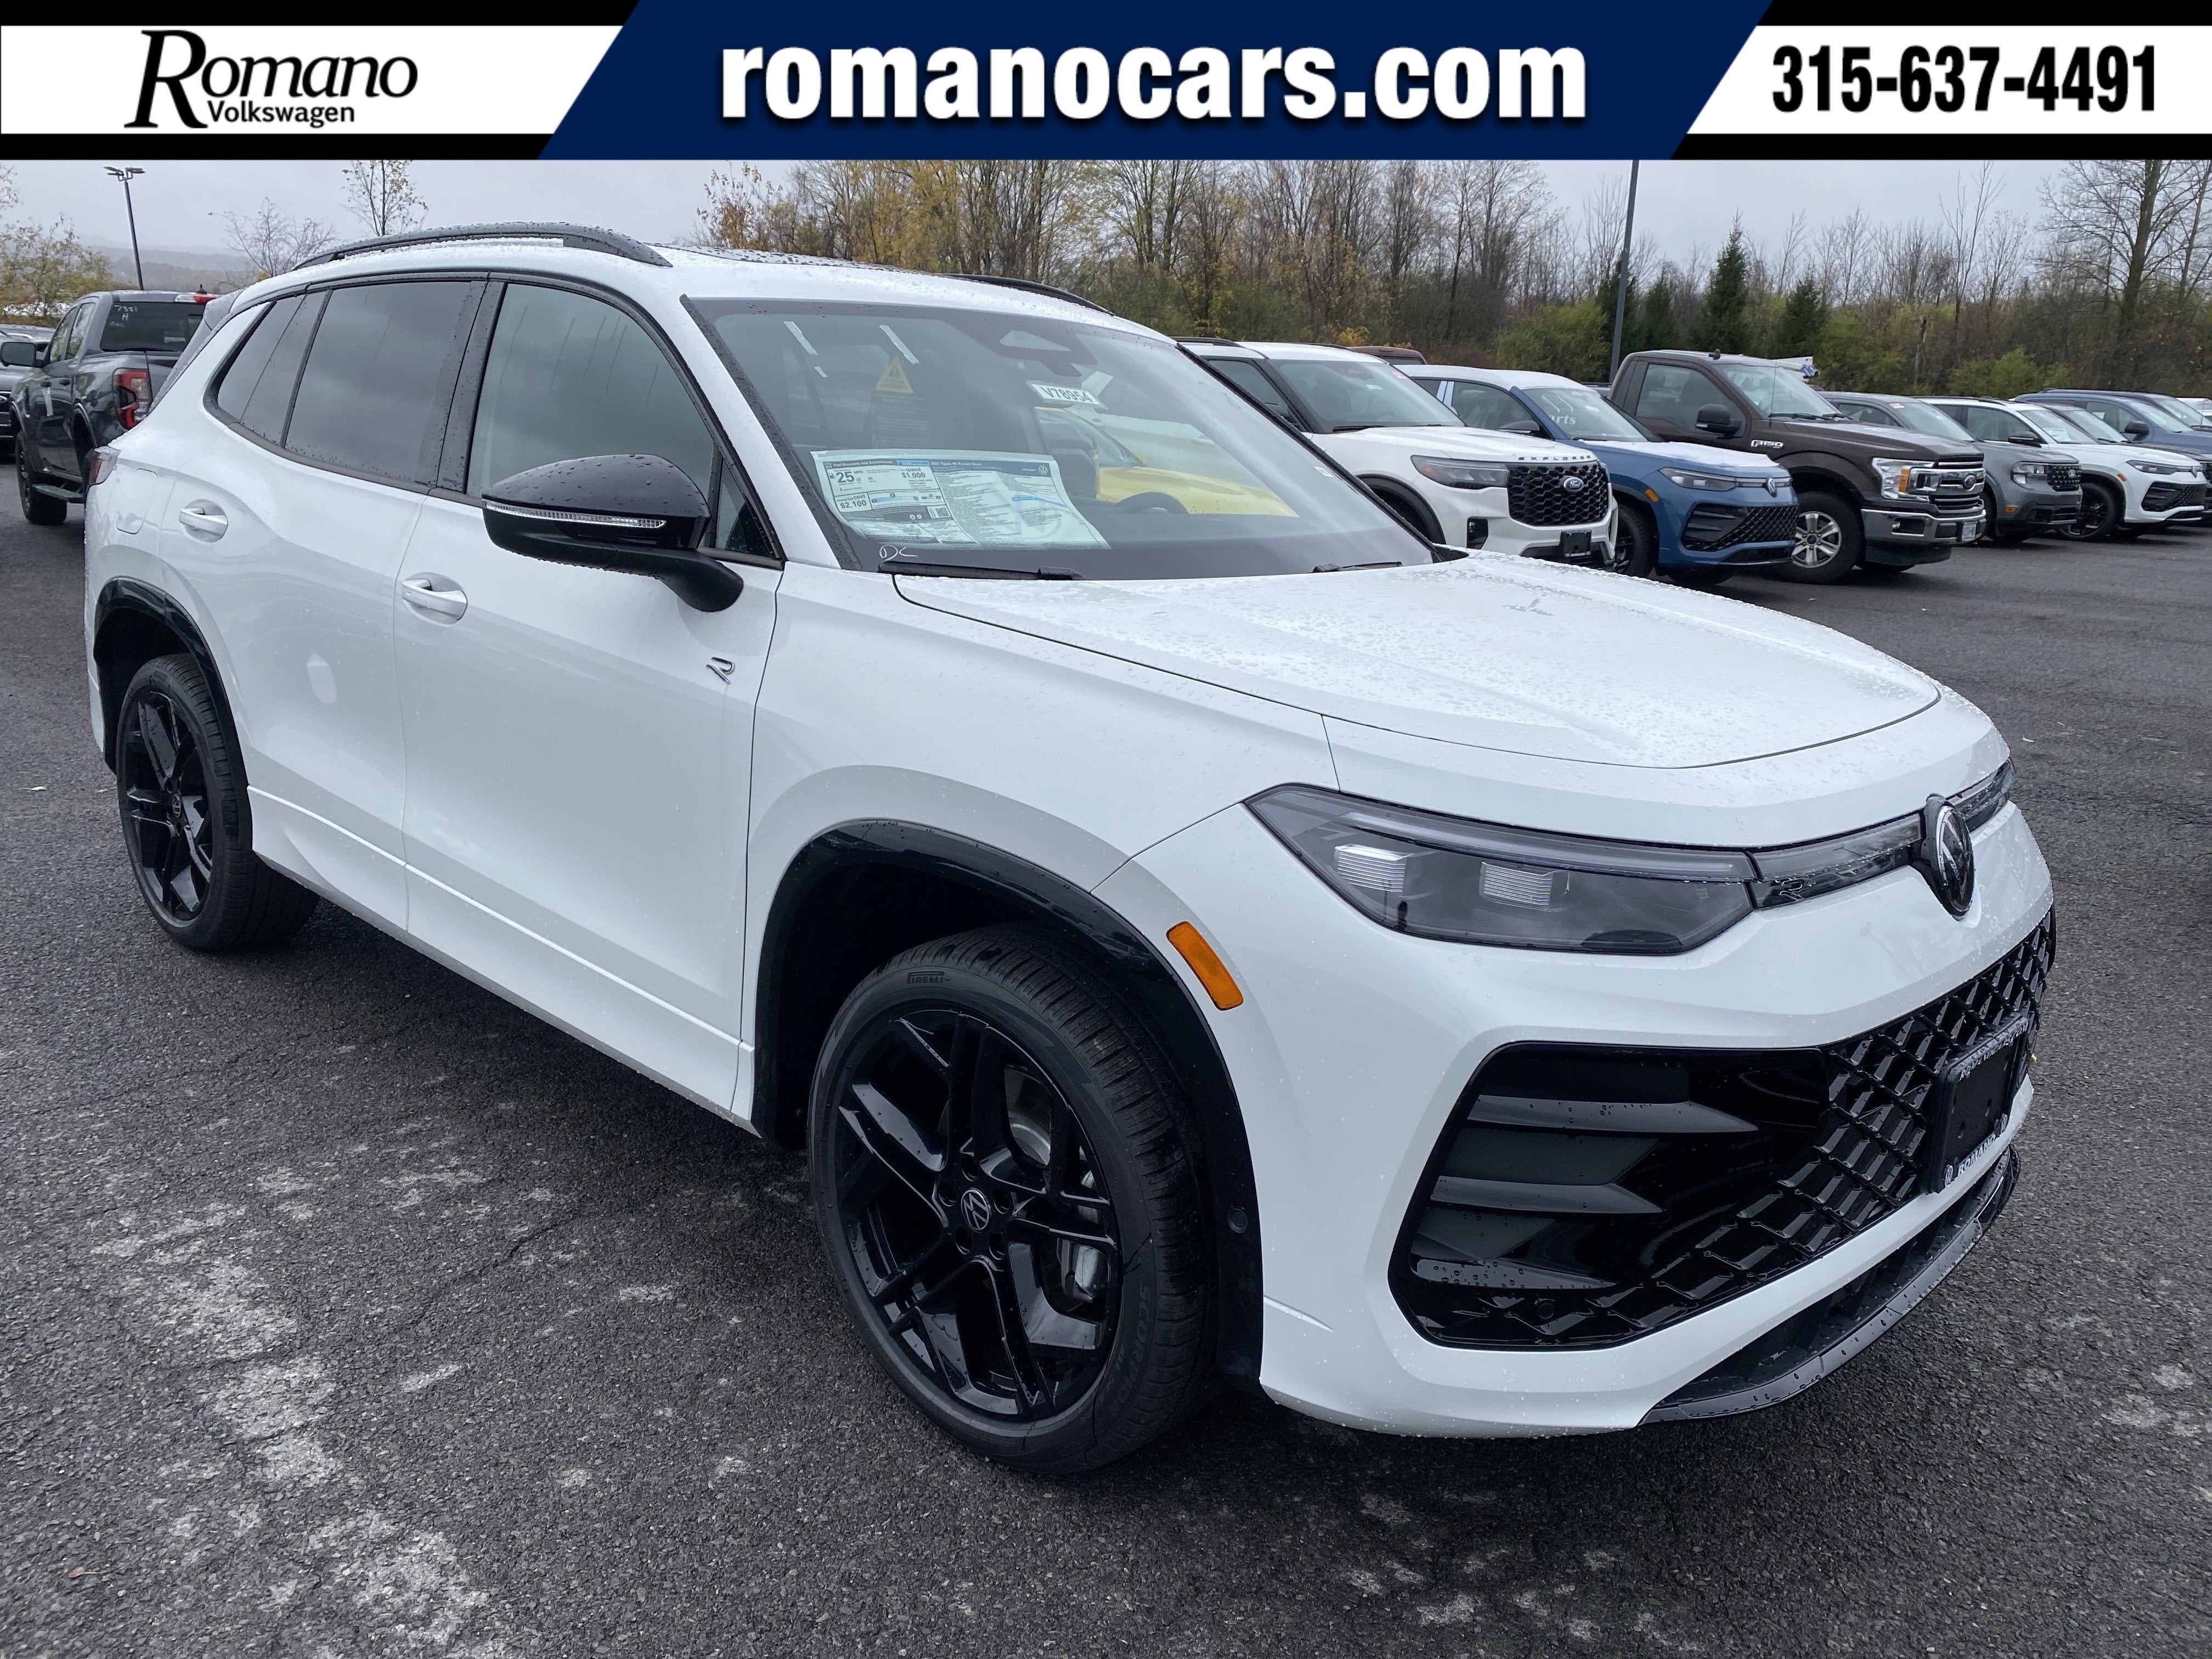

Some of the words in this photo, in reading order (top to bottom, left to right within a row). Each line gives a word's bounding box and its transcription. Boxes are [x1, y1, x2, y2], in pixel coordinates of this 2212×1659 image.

[1040, 387, 1093, 403] V78954
[836, 471, 855, 483] 25
[840, 500, 867, 509] $2,100
[906, 971, 945, 984] PIRELLI
[1957, 1133, 1996, 1176] ROMANO
